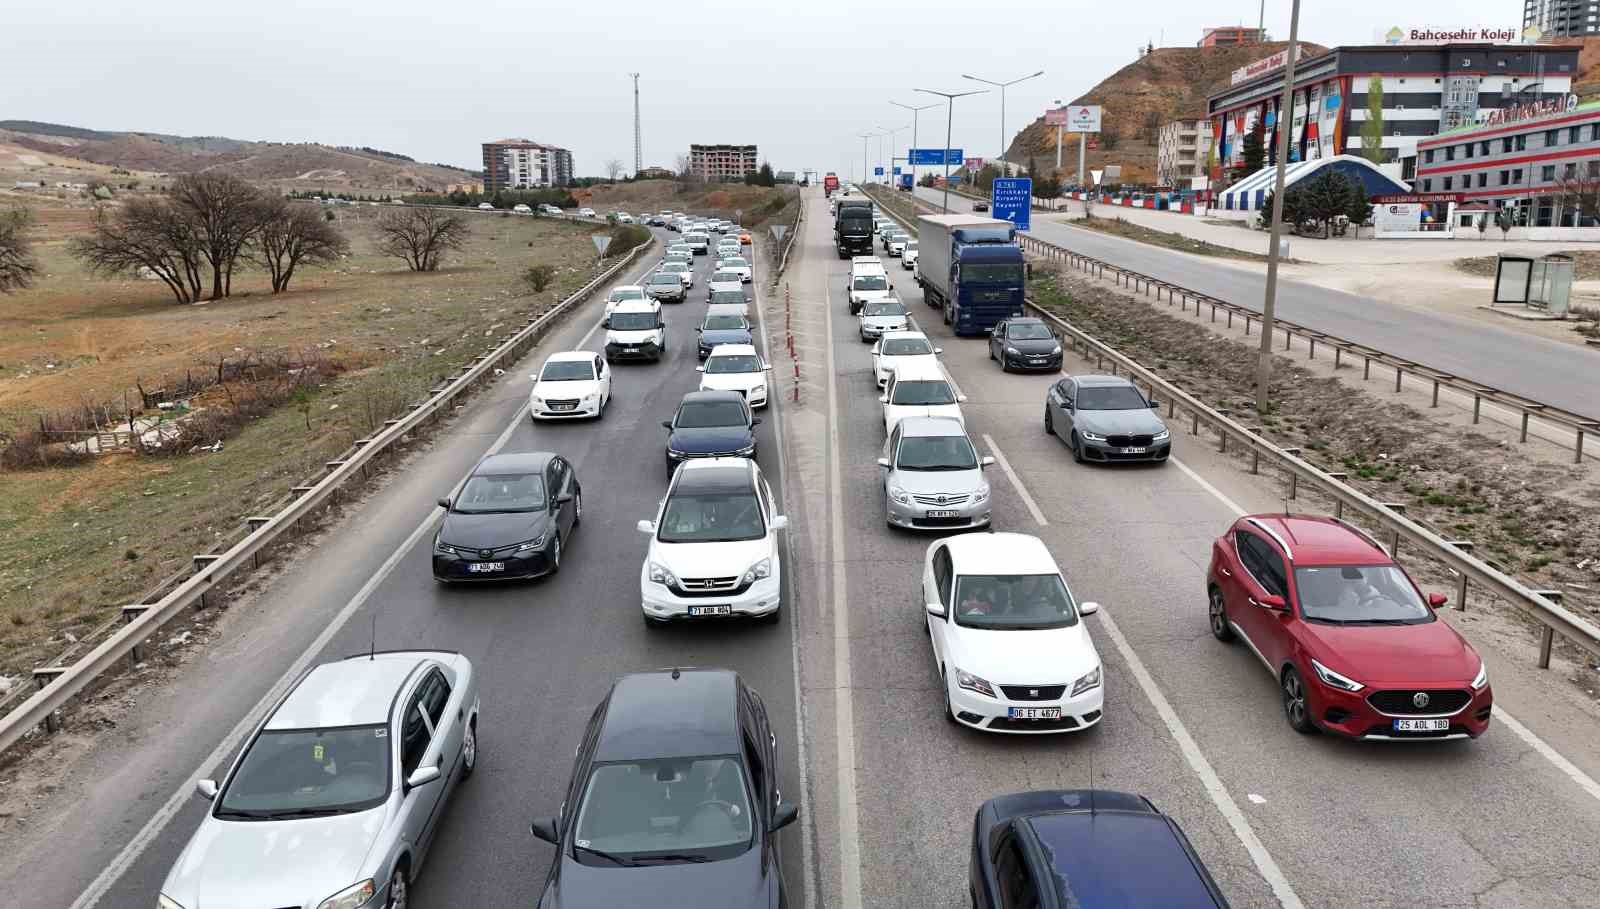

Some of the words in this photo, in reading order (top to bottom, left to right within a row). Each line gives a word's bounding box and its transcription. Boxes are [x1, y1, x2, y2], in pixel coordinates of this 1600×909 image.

[1480, 28, 1516, 42] Koleji
[1014, 709, 1024, 718] 06
[1027, 709, 1037, 718] ET
[1041, 709, 1060, 718] 4677
[1400, 720, 1410, 729] 25
[1433, 720, 1448, 729] 180
